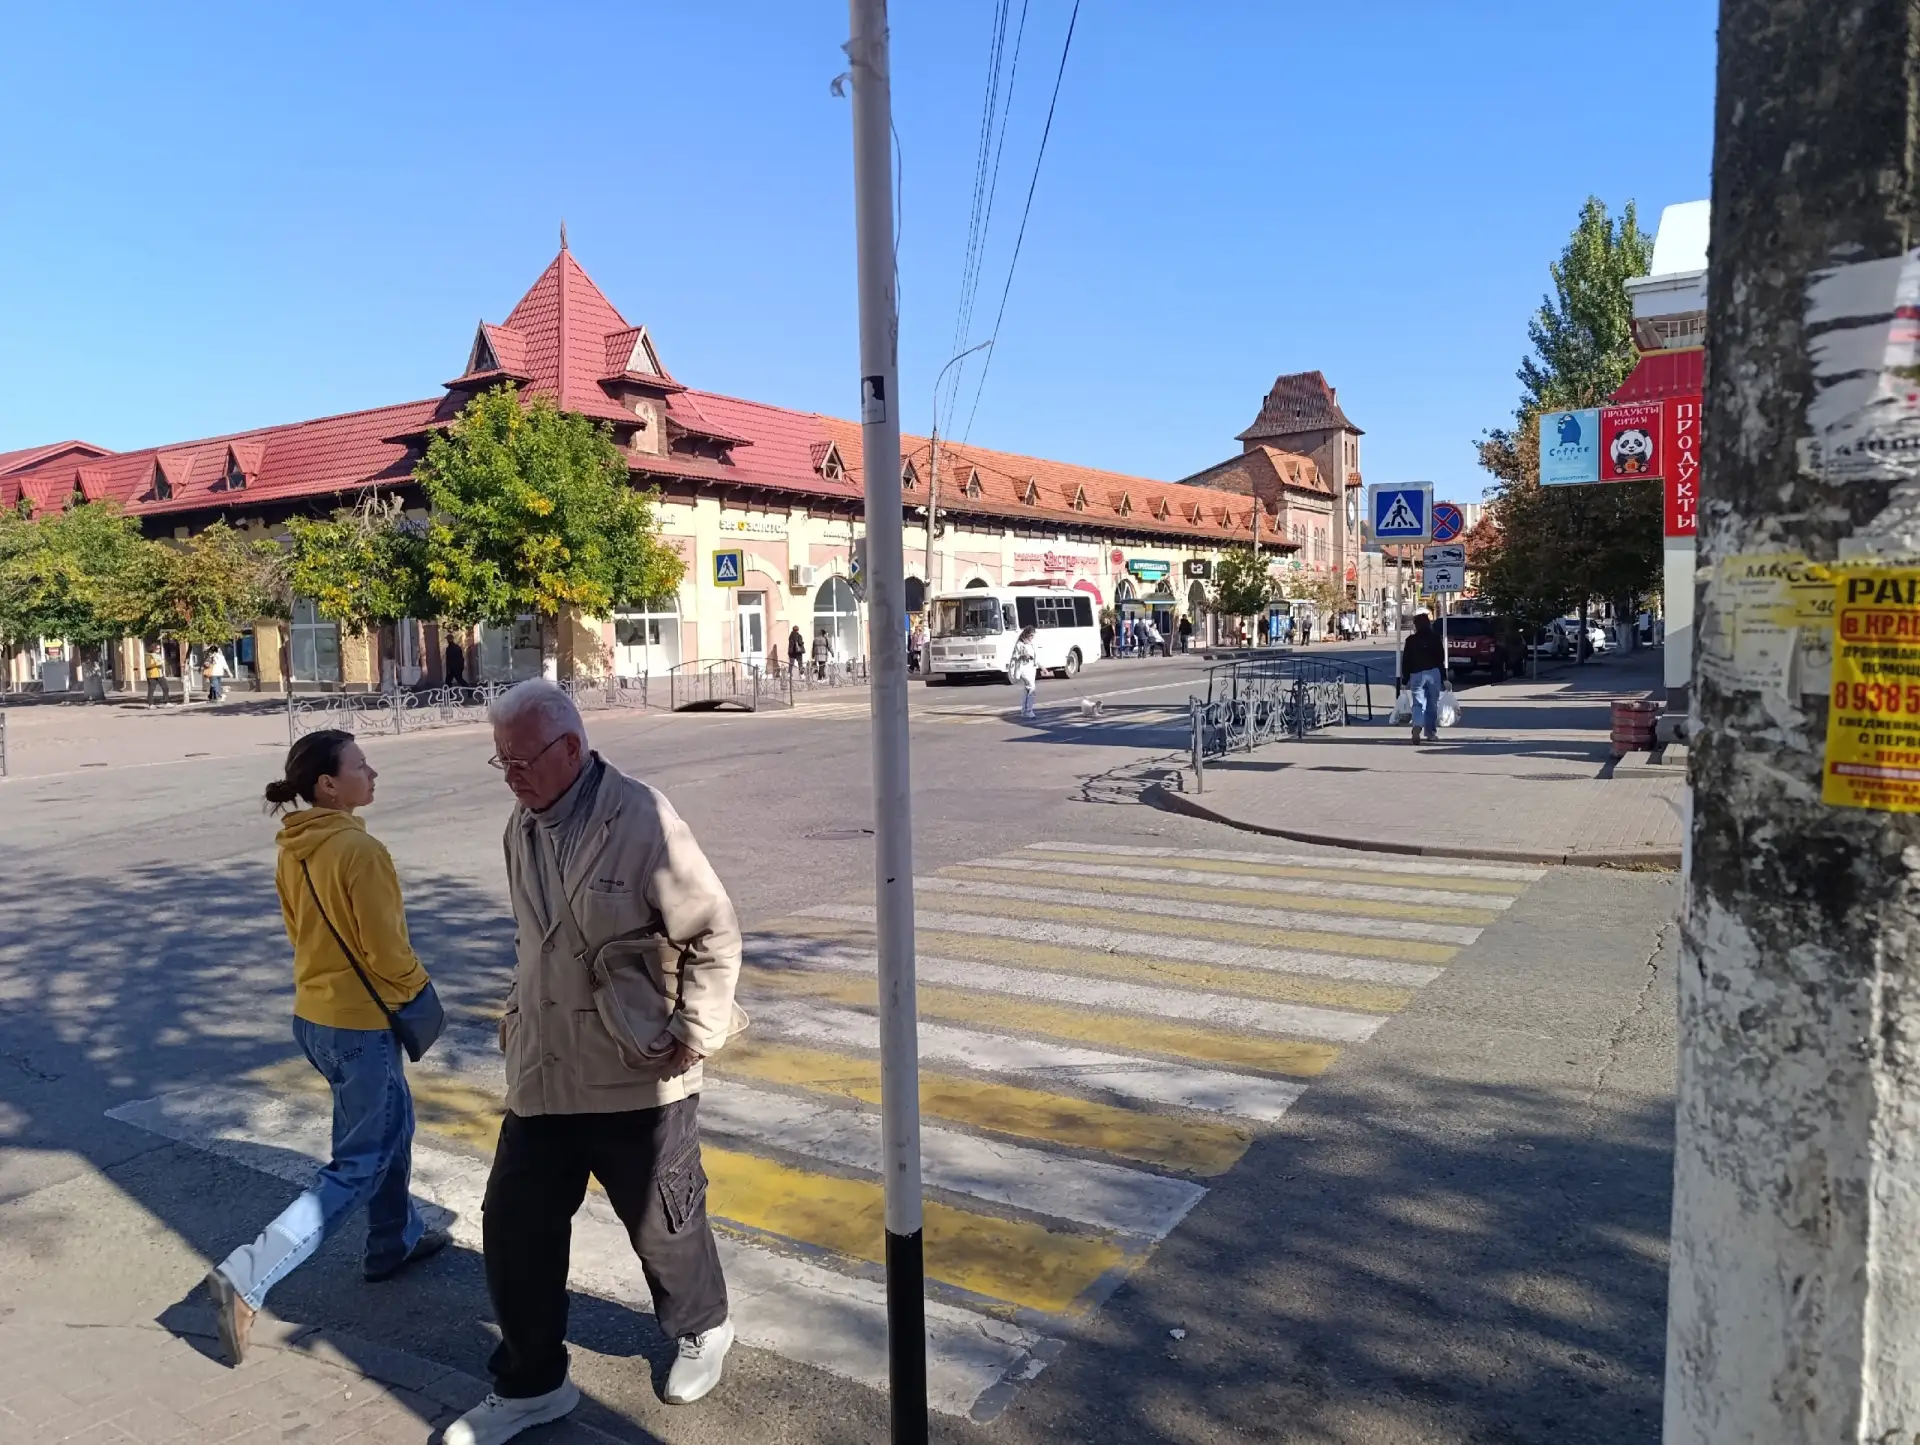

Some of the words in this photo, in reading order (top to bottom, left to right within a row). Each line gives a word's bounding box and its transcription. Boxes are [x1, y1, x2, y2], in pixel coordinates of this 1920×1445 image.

[1603, 406, 1660, 418] ПРОДУКТЫ
[1614, 416, 1648, 427] КИТАЯ
[1677, 403, 1698, 529] ПРОДУКТЫ
[1190, 562, 1204, 574] t2
[1443, 641, 1477, 649] SUZU
